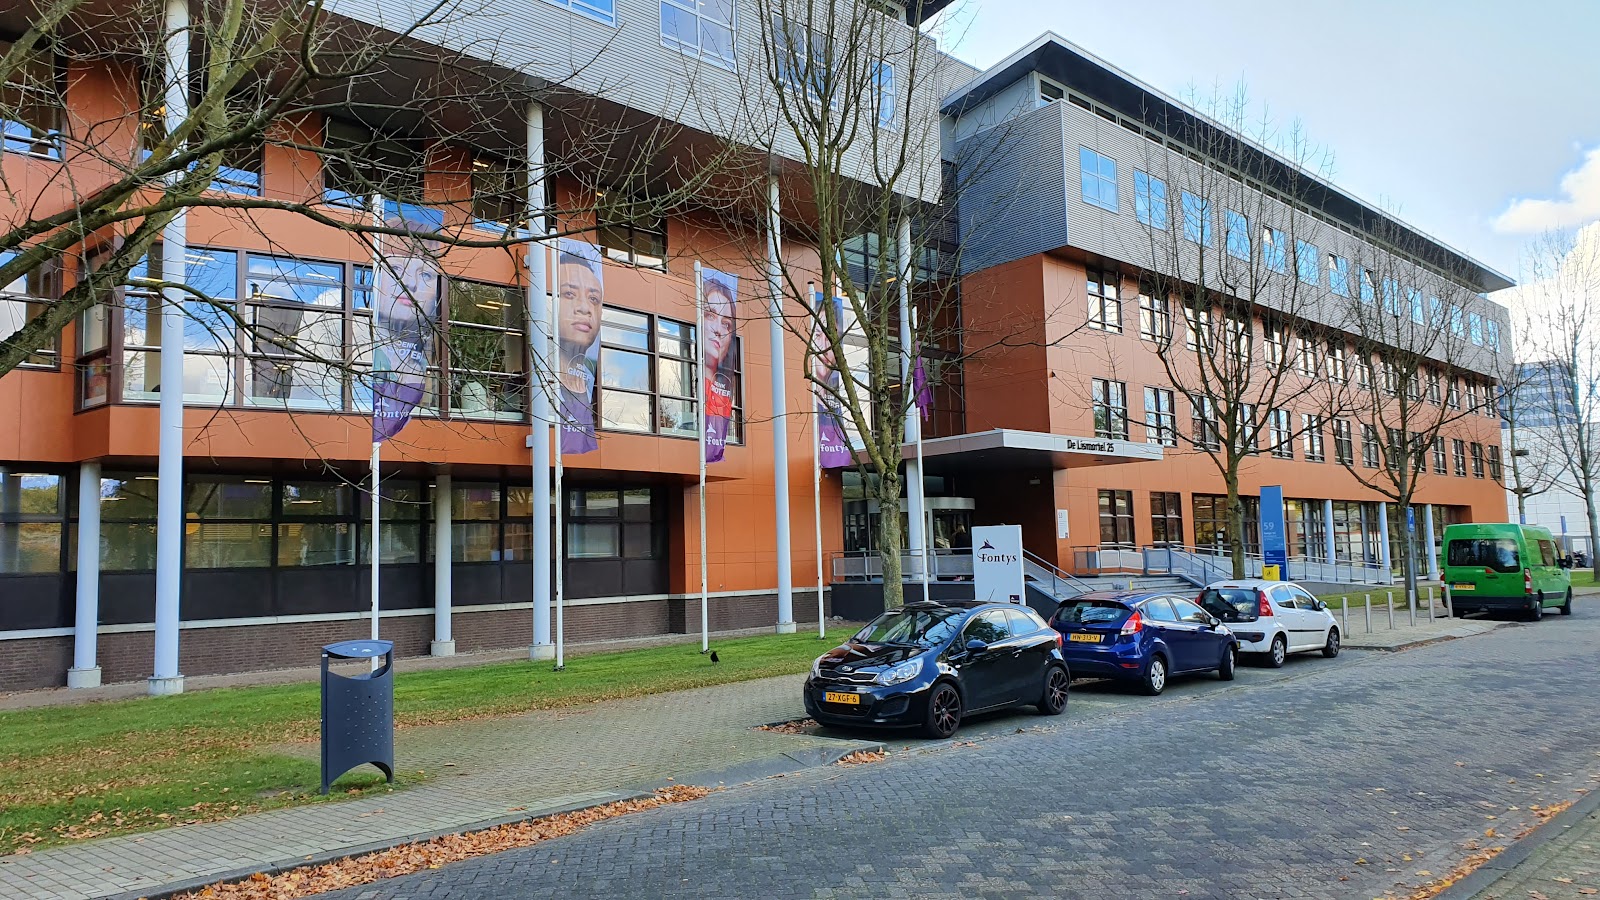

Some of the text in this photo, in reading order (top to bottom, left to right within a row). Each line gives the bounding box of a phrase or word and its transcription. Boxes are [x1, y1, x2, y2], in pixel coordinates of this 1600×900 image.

[1067, 440, 1076, 449] De
[1107, 443, 1114, 452] 25
[1264, 522, 1274, 530] 59
[981, 553, 1017, 565] Fontys
[828, 692, 857, 702] 27-XGF-6
